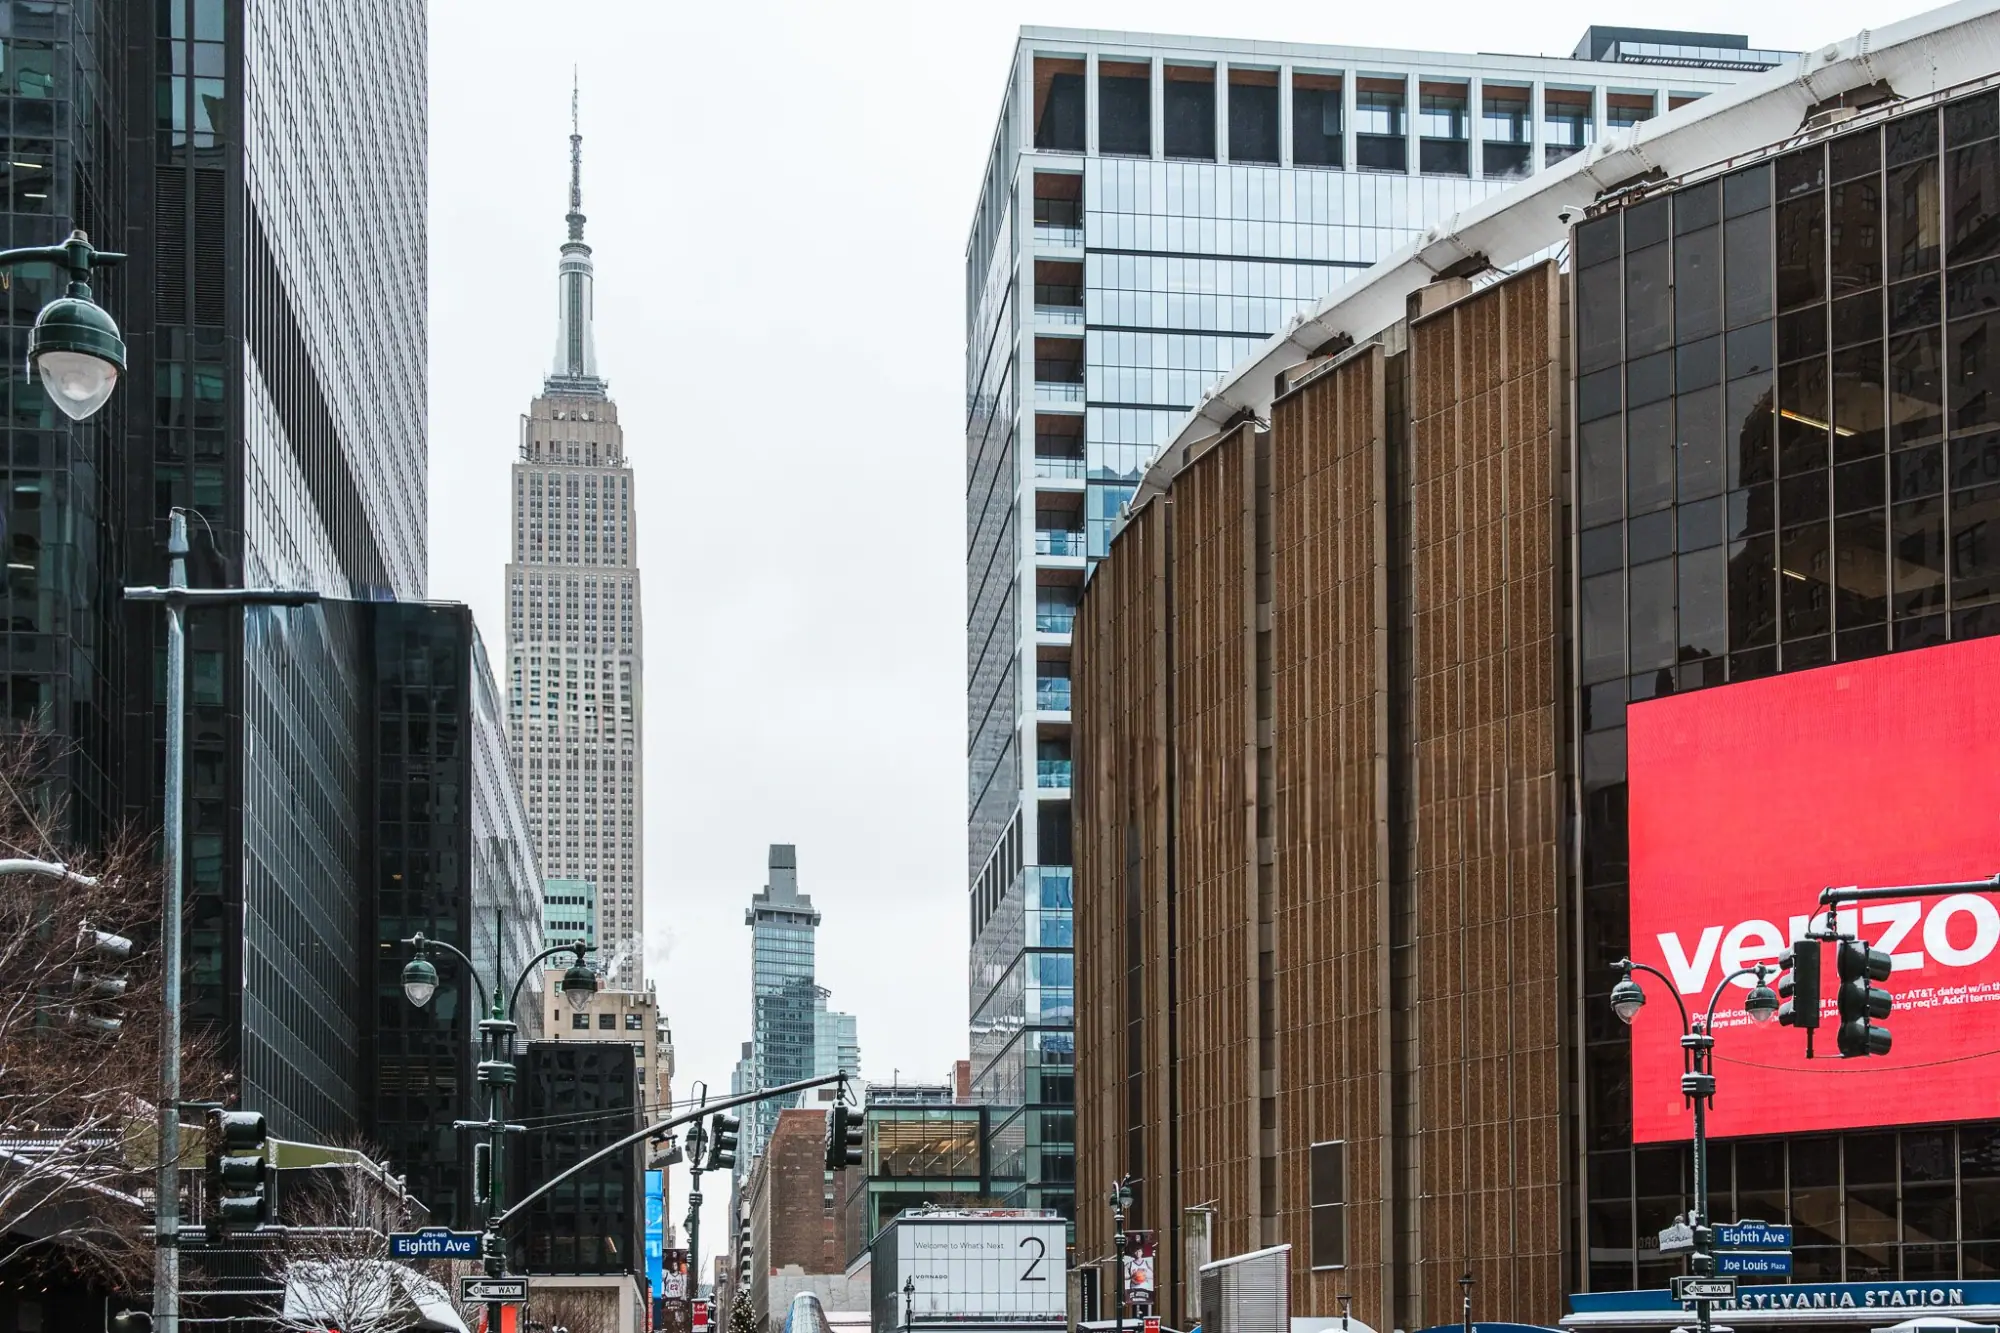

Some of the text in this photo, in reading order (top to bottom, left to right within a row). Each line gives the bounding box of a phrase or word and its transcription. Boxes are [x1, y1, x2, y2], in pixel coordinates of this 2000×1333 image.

[1907, 988, 1936, 999] AT&T,
[1937, 985, 1966, 996] dated
[1968, 983, 1991, 993] w/in
[1970, 993, 2000, 1003] terms
[1730, 1017, 1746, 1026] and
[1723, 1230, 1785, 1245] Eighth Ave
[398, 1239, 471, 1255] Eighth Ave
[1019, 1236, 1046, 1281] 2
[1723, 1259, 1740, 1271] Joe
[1743, 1259, 1768, 1270] Louis
[473, 1286, 517, 1294] ONE WAY
[1688, 1284, 1727, 1293] ONE WAY
[1682, 1288, 1963, 1311] PNNSYLVANIA STATION
